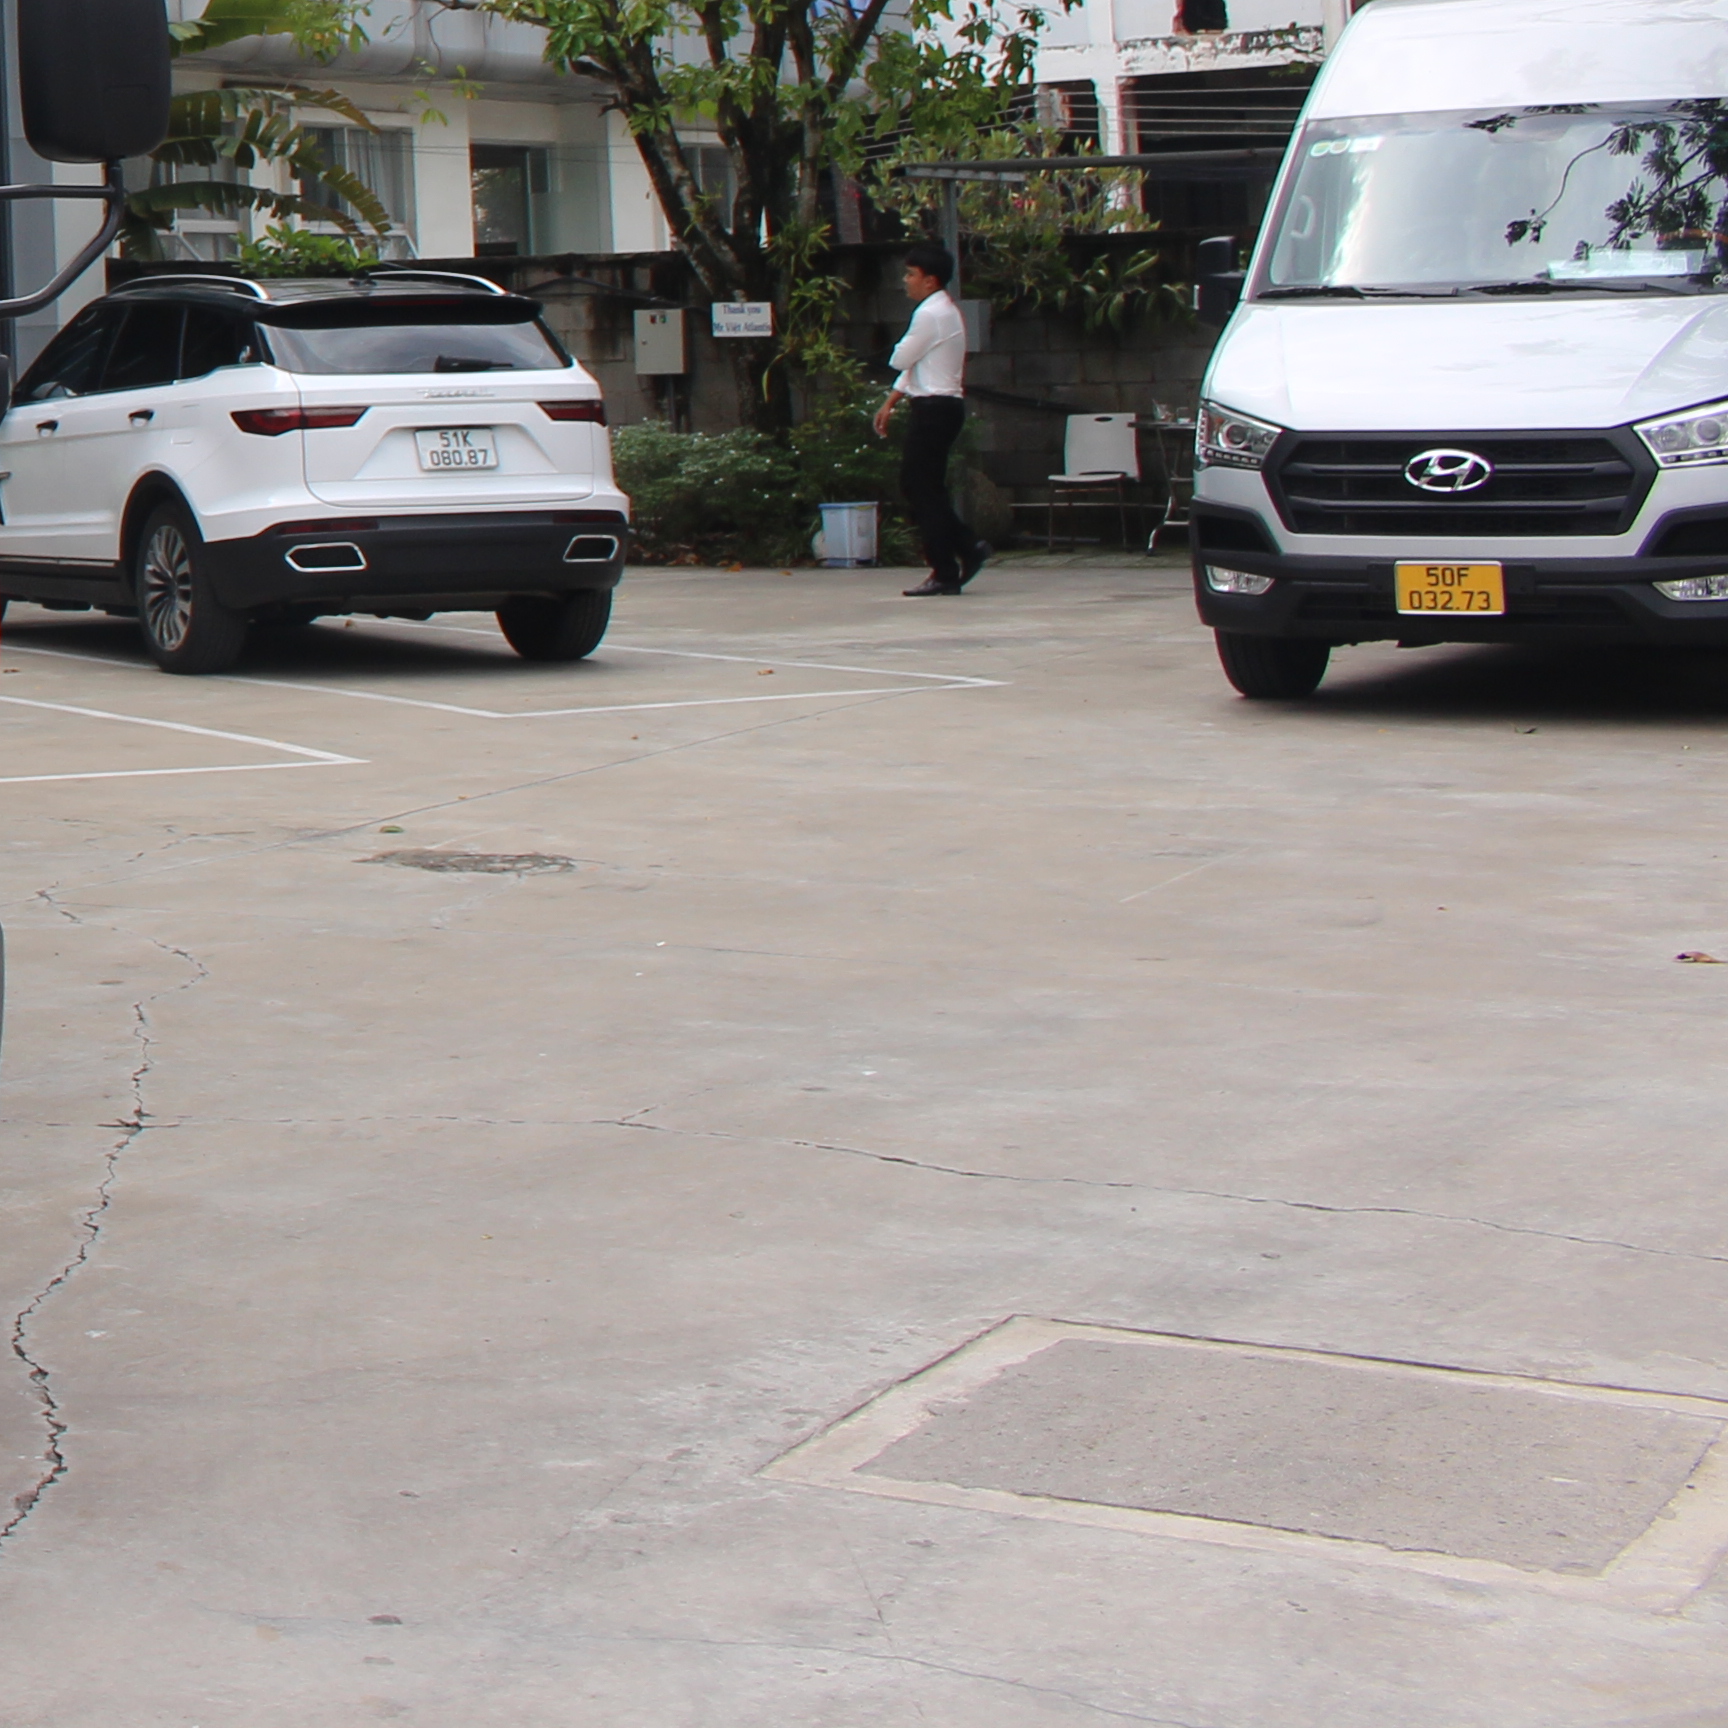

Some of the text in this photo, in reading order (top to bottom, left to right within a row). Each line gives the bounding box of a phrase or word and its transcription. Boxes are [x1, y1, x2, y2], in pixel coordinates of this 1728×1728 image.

[439, 431, 473, 448] 51K
[429, 449, 488, 466] 080.87
[1425, 566, 1470, 587] 50F
[1408, 590, 1491, 611] 032.73
